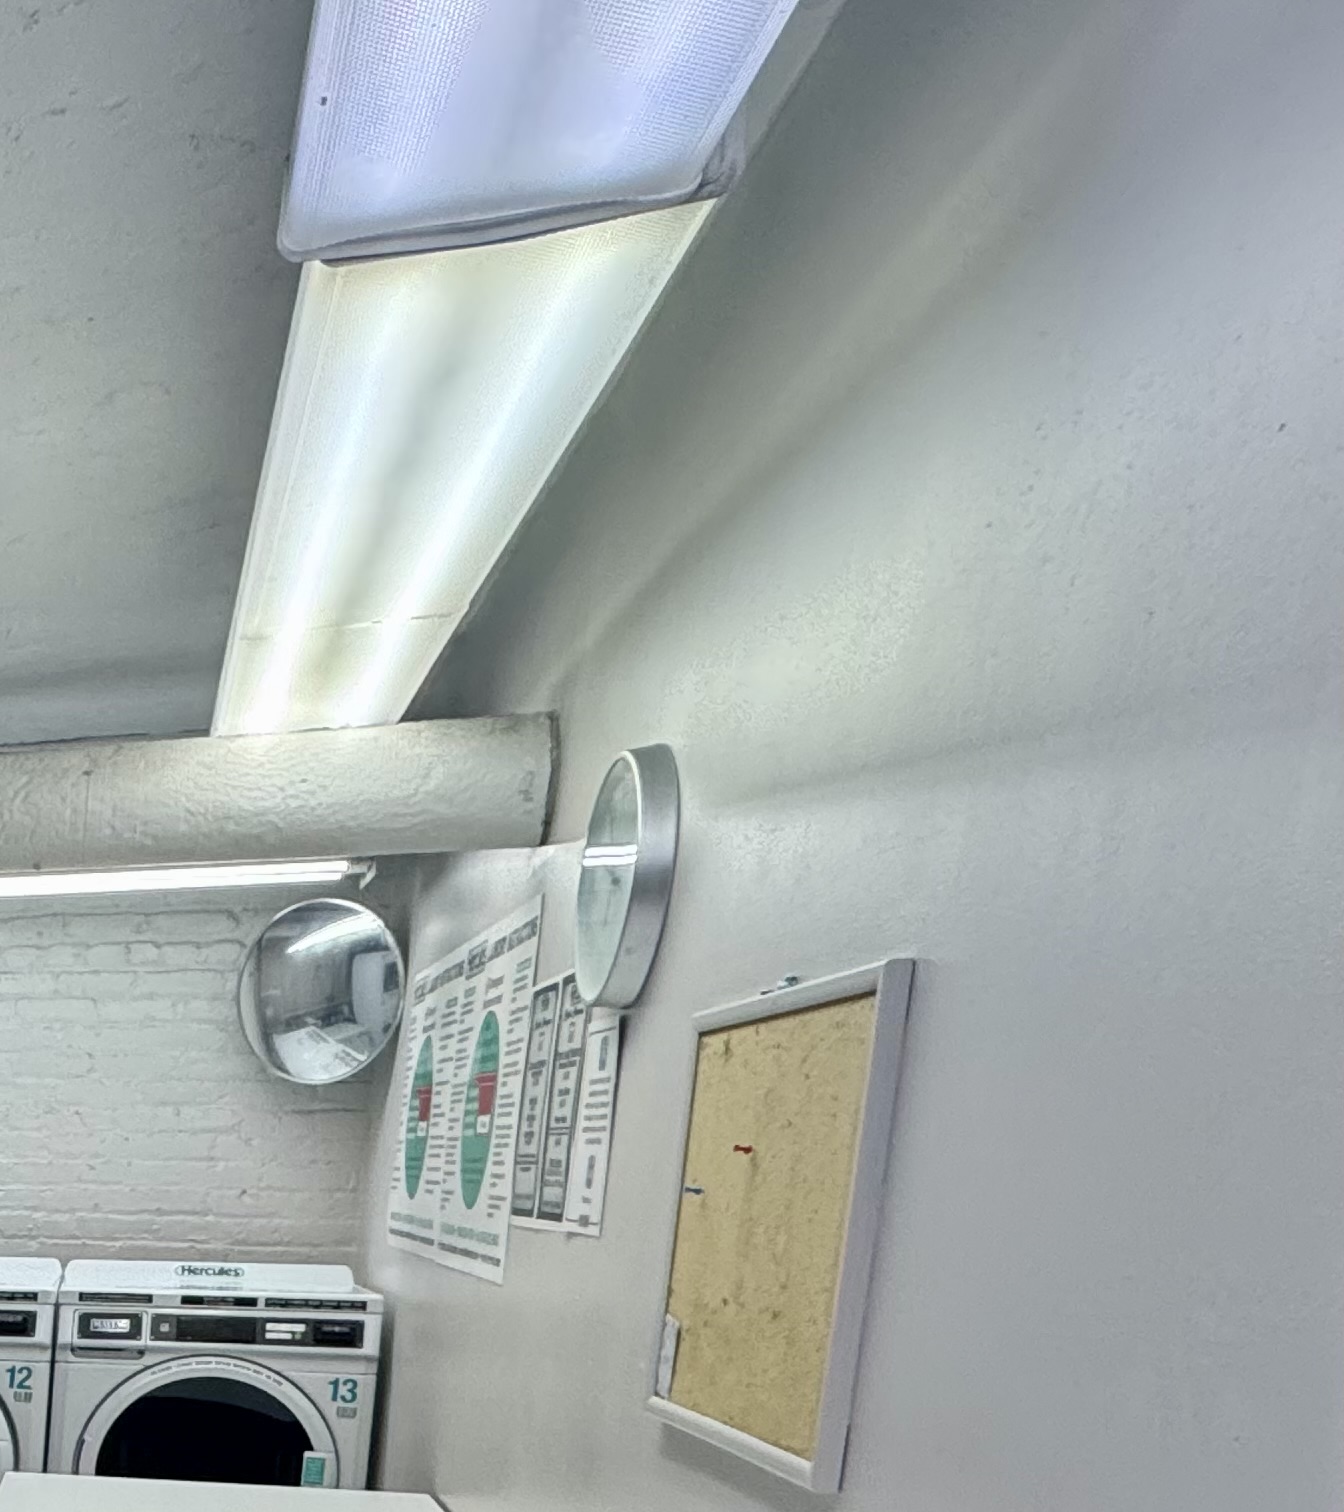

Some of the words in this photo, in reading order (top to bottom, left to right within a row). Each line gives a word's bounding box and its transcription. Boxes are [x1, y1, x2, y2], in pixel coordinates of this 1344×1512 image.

[180, 1265, 241, 1278] Hercules
[5, 1365, 33, 1390] 12
[327, 1378, 358, 1404] 13
